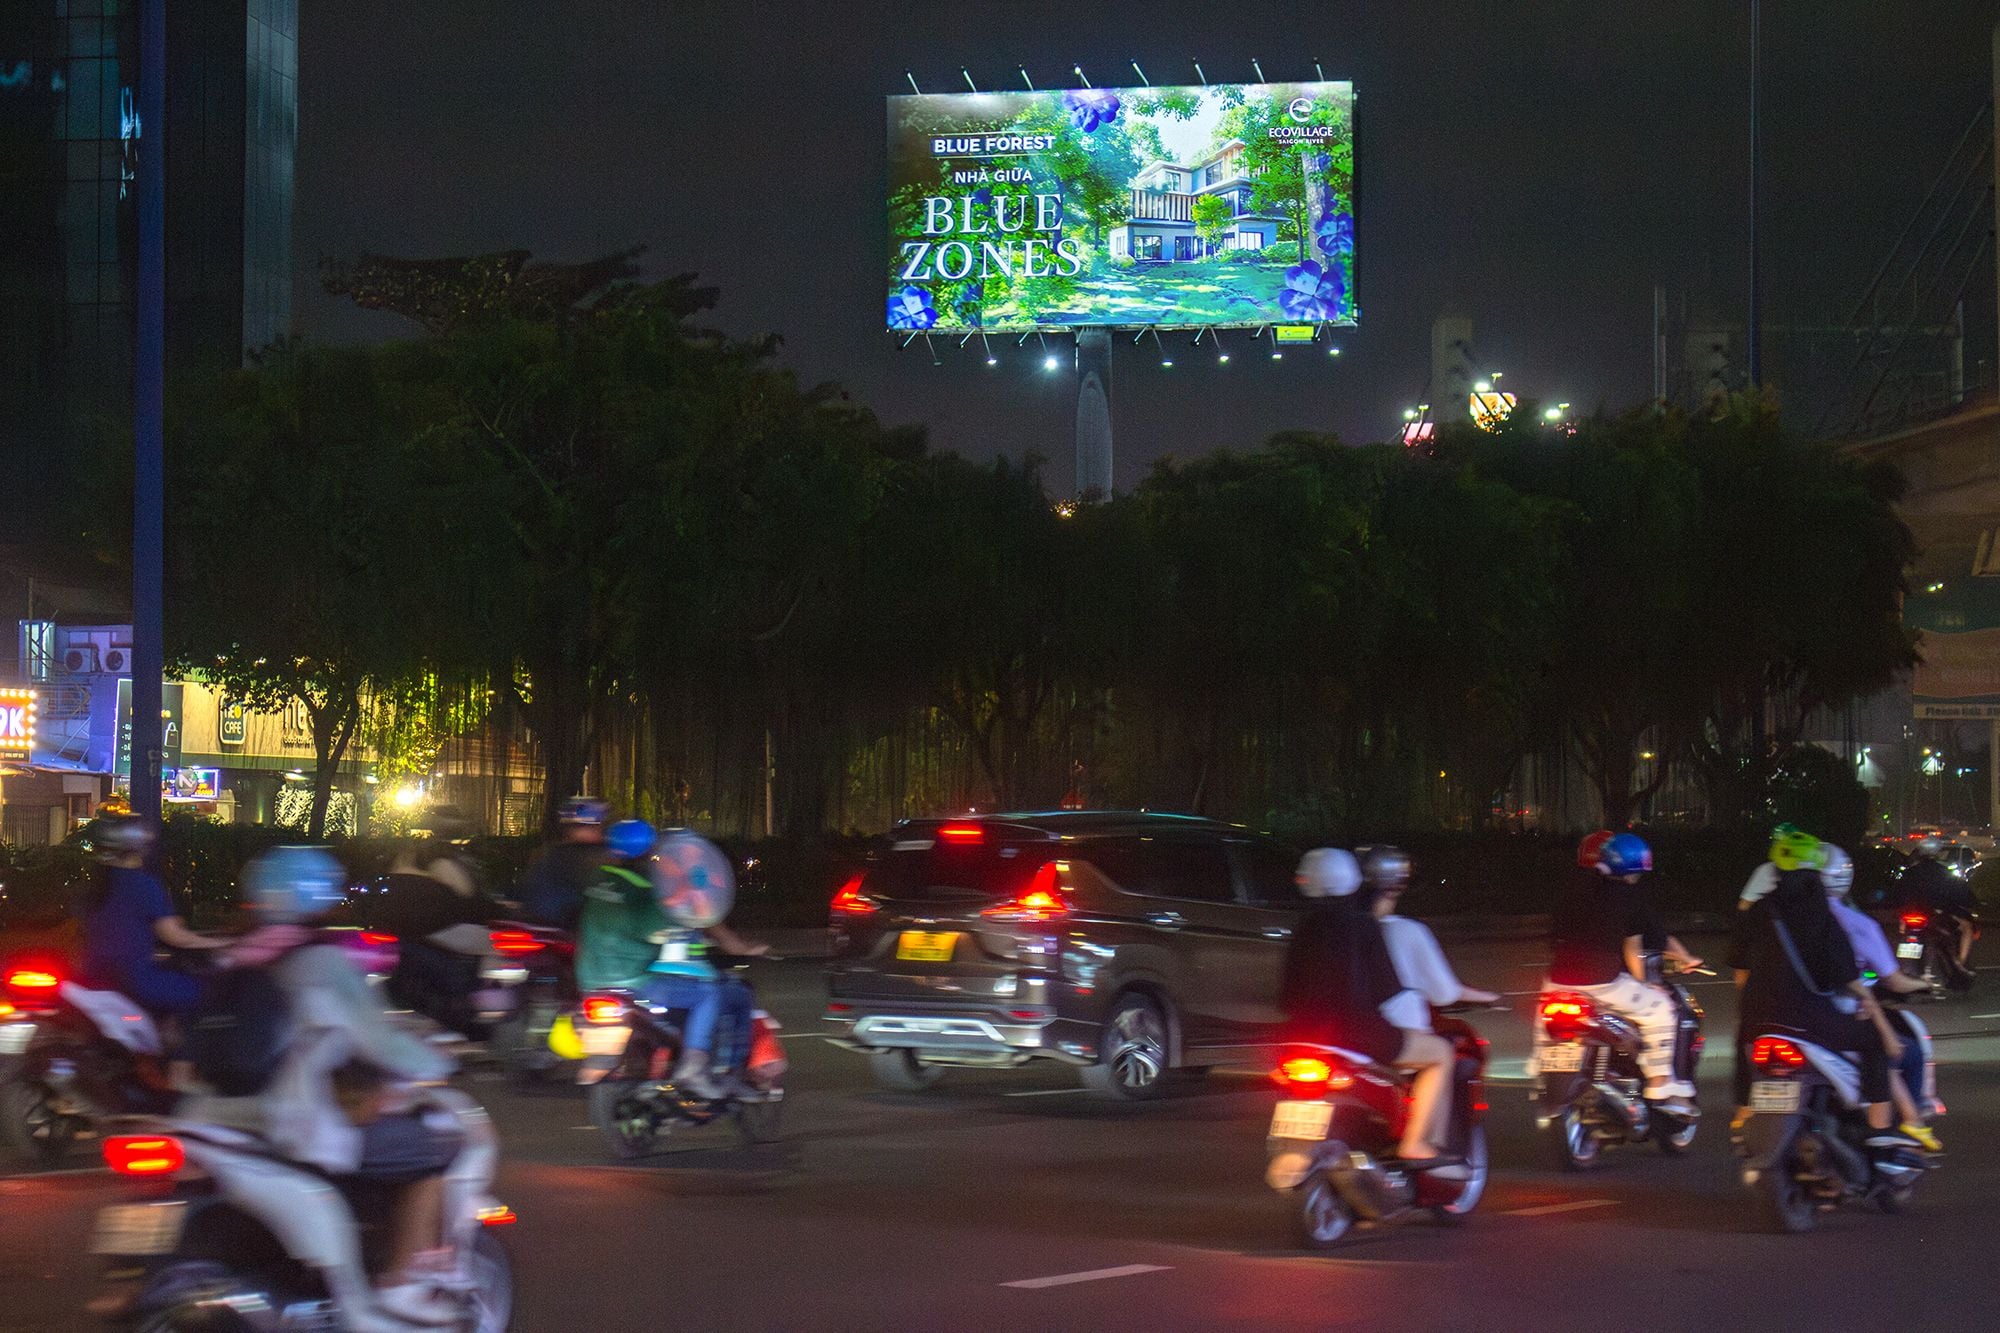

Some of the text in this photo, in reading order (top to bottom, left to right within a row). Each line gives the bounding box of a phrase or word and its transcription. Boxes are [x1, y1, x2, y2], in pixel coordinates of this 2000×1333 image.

[1269, 126, 1333, 137] ECOVILLAGE
[934, 136, 1056, 153] BLUE FOREST
[955, 167, 989, 183] NHÀ
[923, 194, 1063, 234] BLUE
[902, 238, 1081, 280] ZONES
